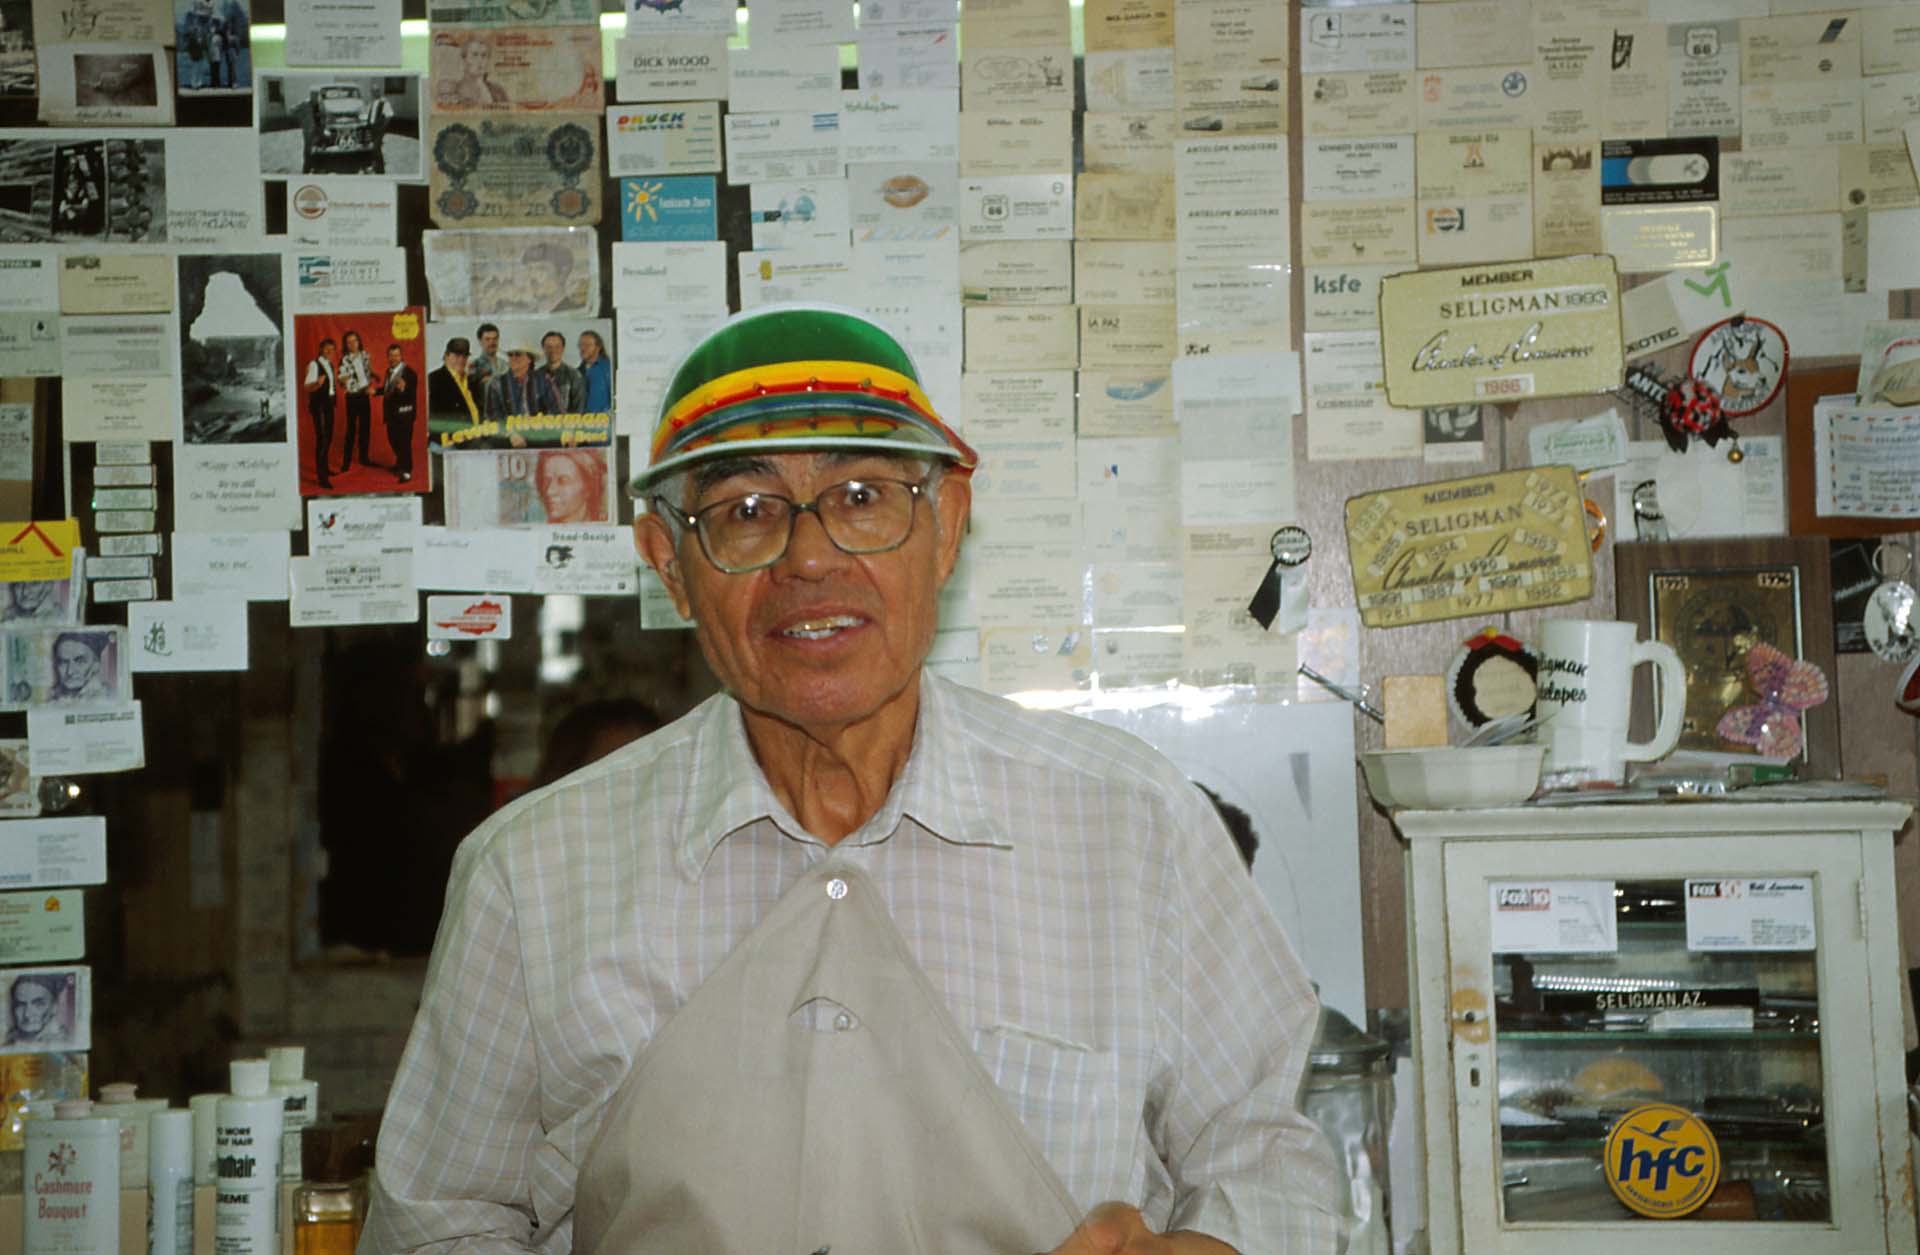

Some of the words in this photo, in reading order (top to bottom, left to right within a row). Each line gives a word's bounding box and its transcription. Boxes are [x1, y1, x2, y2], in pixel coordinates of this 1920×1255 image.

[633, 56, 663, 69] DICK
[667, 55, 710, 67] WOOD
[617, 112, 686, 125] DRUCK
[1313, 273, 1362, 294] ksfe
[1461, 269, 1534, 288] MEMBER
[1439, 292, 1560, 320] SELIGMAN
[1424, 482, 1495, 505] MEMBER
[1405, 505, 1523, 537] SELIGMAN
[1500, 888, 1530, 907] FOX
[1531, 888, 1550, 906] 10
[1691, 883, 1717, 898] FOX
[1618, 1138, 1706, 1192] hfc
[34, 1171, 93, 1195] Cashmere
[38, 1197, 87, 1221] Bouquet
